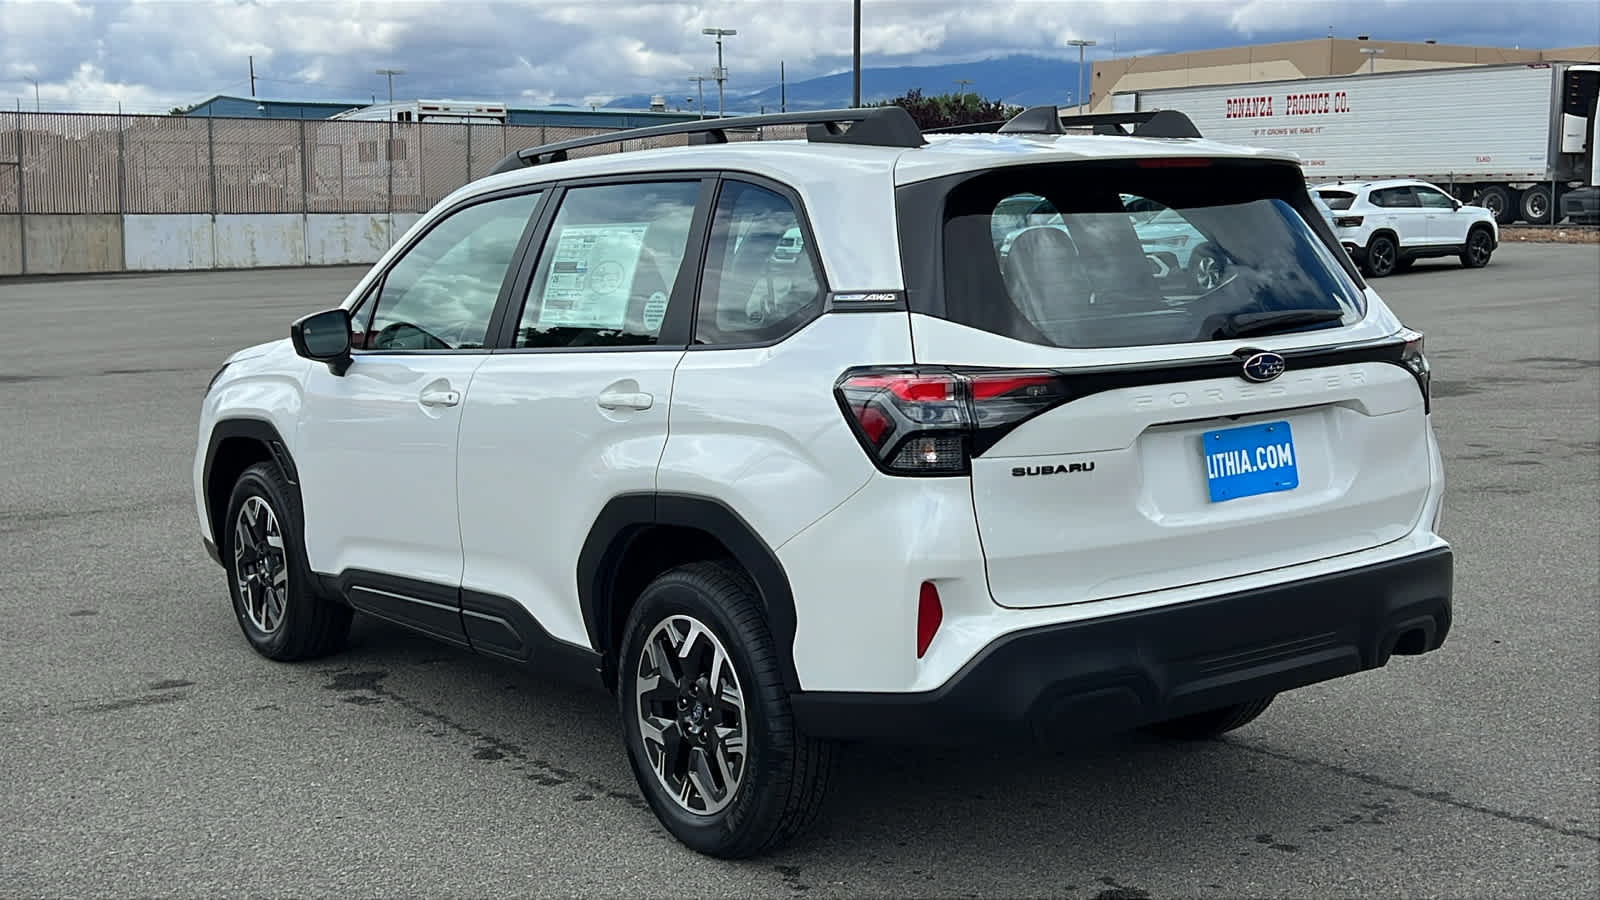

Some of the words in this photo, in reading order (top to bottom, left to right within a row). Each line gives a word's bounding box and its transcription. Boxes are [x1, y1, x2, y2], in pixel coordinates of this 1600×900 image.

[1226, 96, 1273, 118] BONANZA
[1286, 93, 1329, 115] PRODUCE
[1334, 92, 1350, 113] CO.
[1135, 371, 1367, 407] FORESTER
[1012, 461, 1095, 477] SUBARU
[1206, 442, 1293, 479] LITHIA.COM
